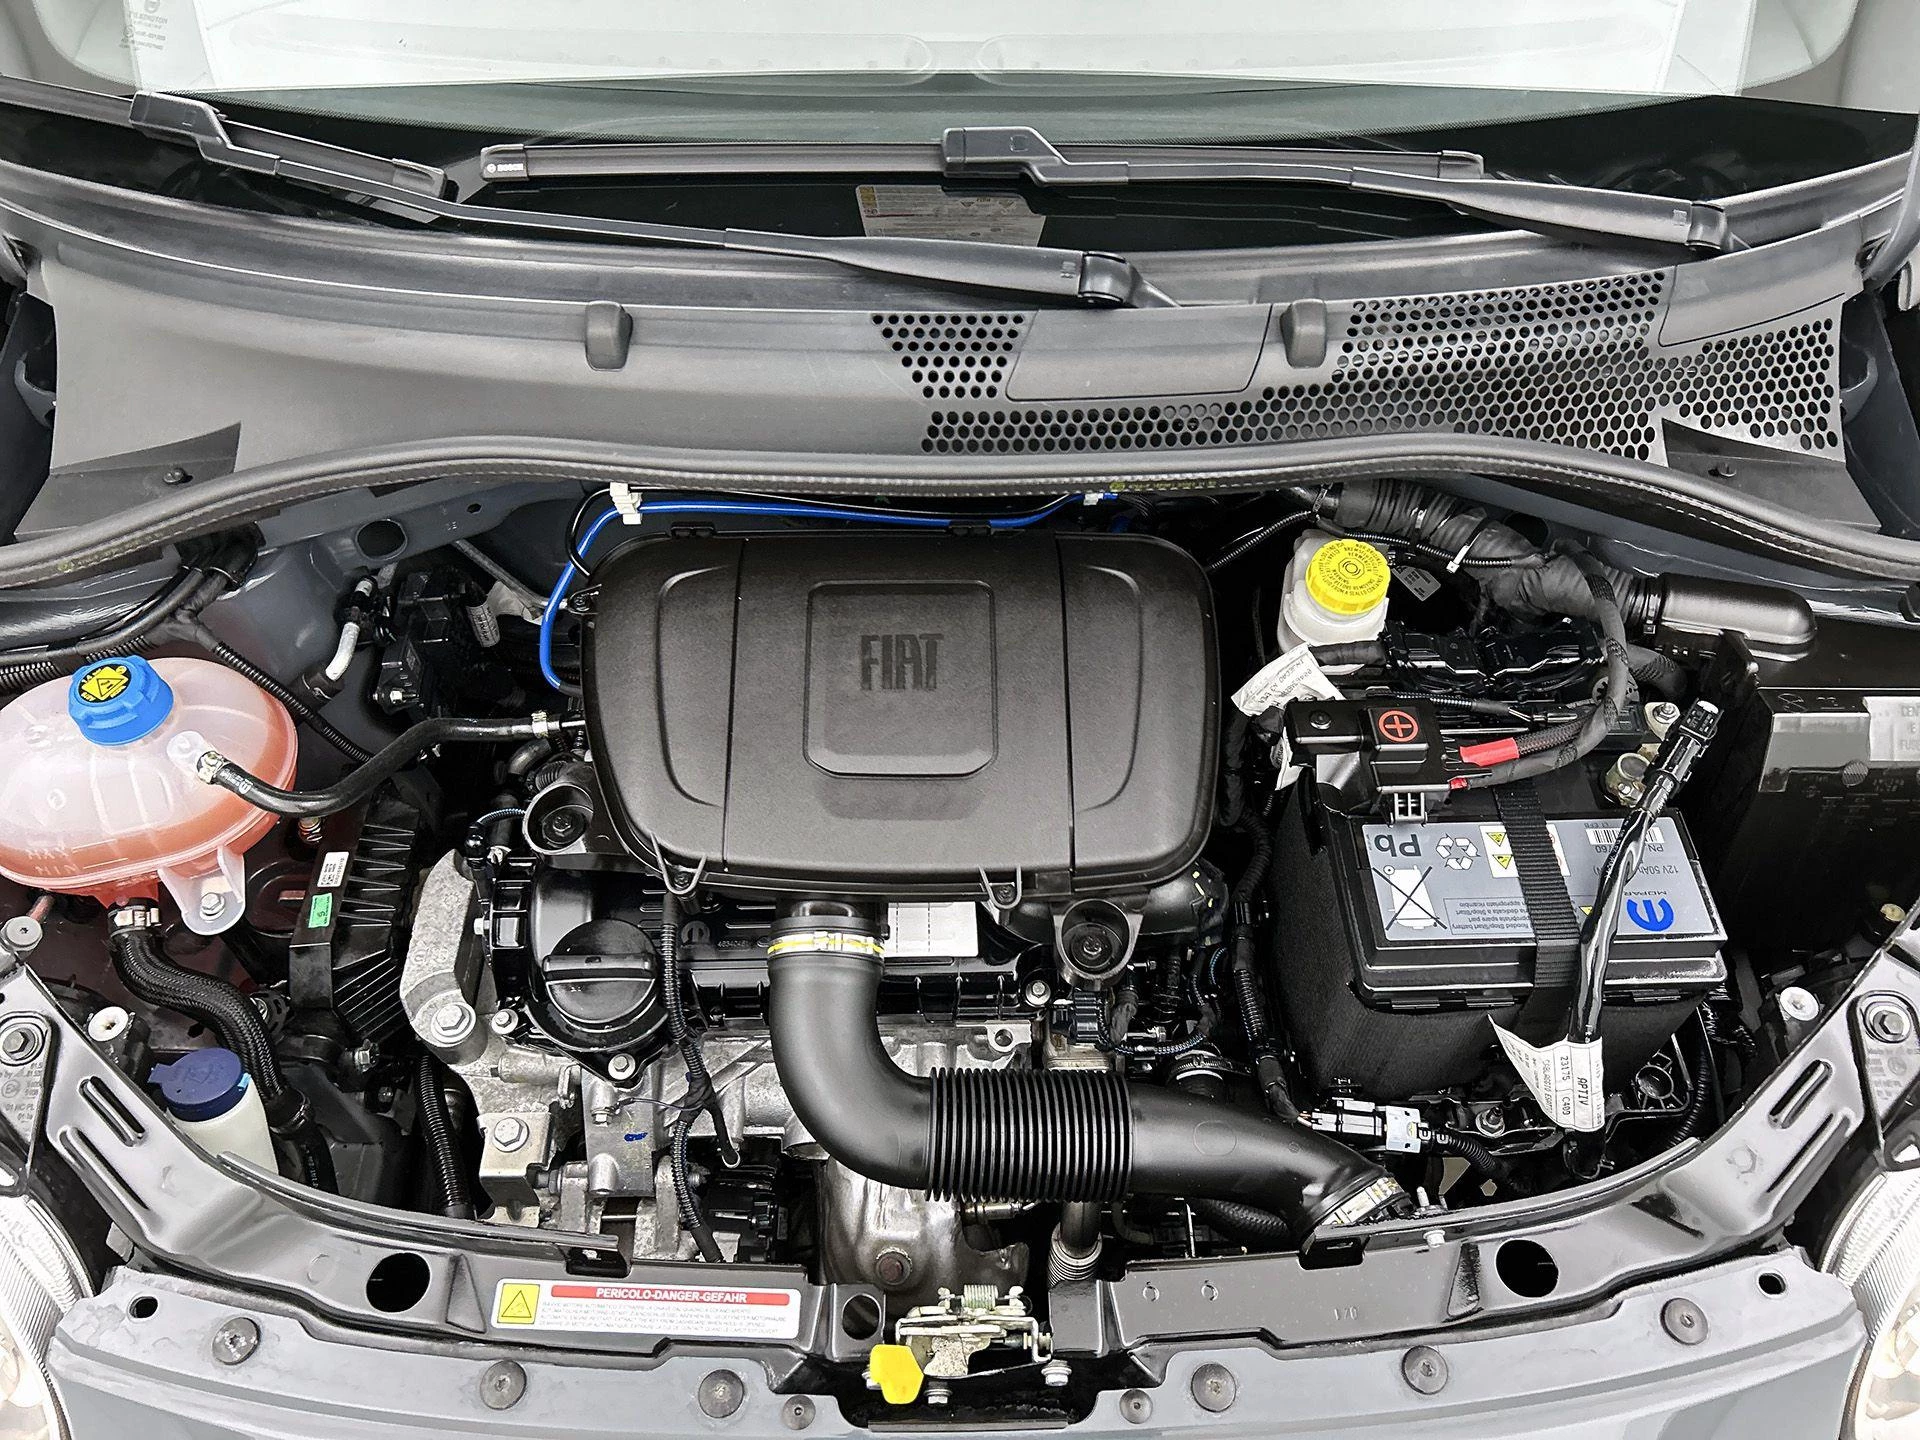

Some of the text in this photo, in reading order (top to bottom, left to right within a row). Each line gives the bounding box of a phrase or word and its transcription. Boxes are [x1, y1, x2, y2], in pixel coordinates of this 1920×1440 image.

[861, 633, 944, 690] FIAT
[1374, 833, 1422, 857] Pb
[1662, 865, 1679, 875] 12V
[1560, 1055, 1571, 1081] 23175
[1577, 1077, 1589, 1106] APTIV
[596, 1287, 747, 1303] PERICOLO-DANGER-GEFAHR
